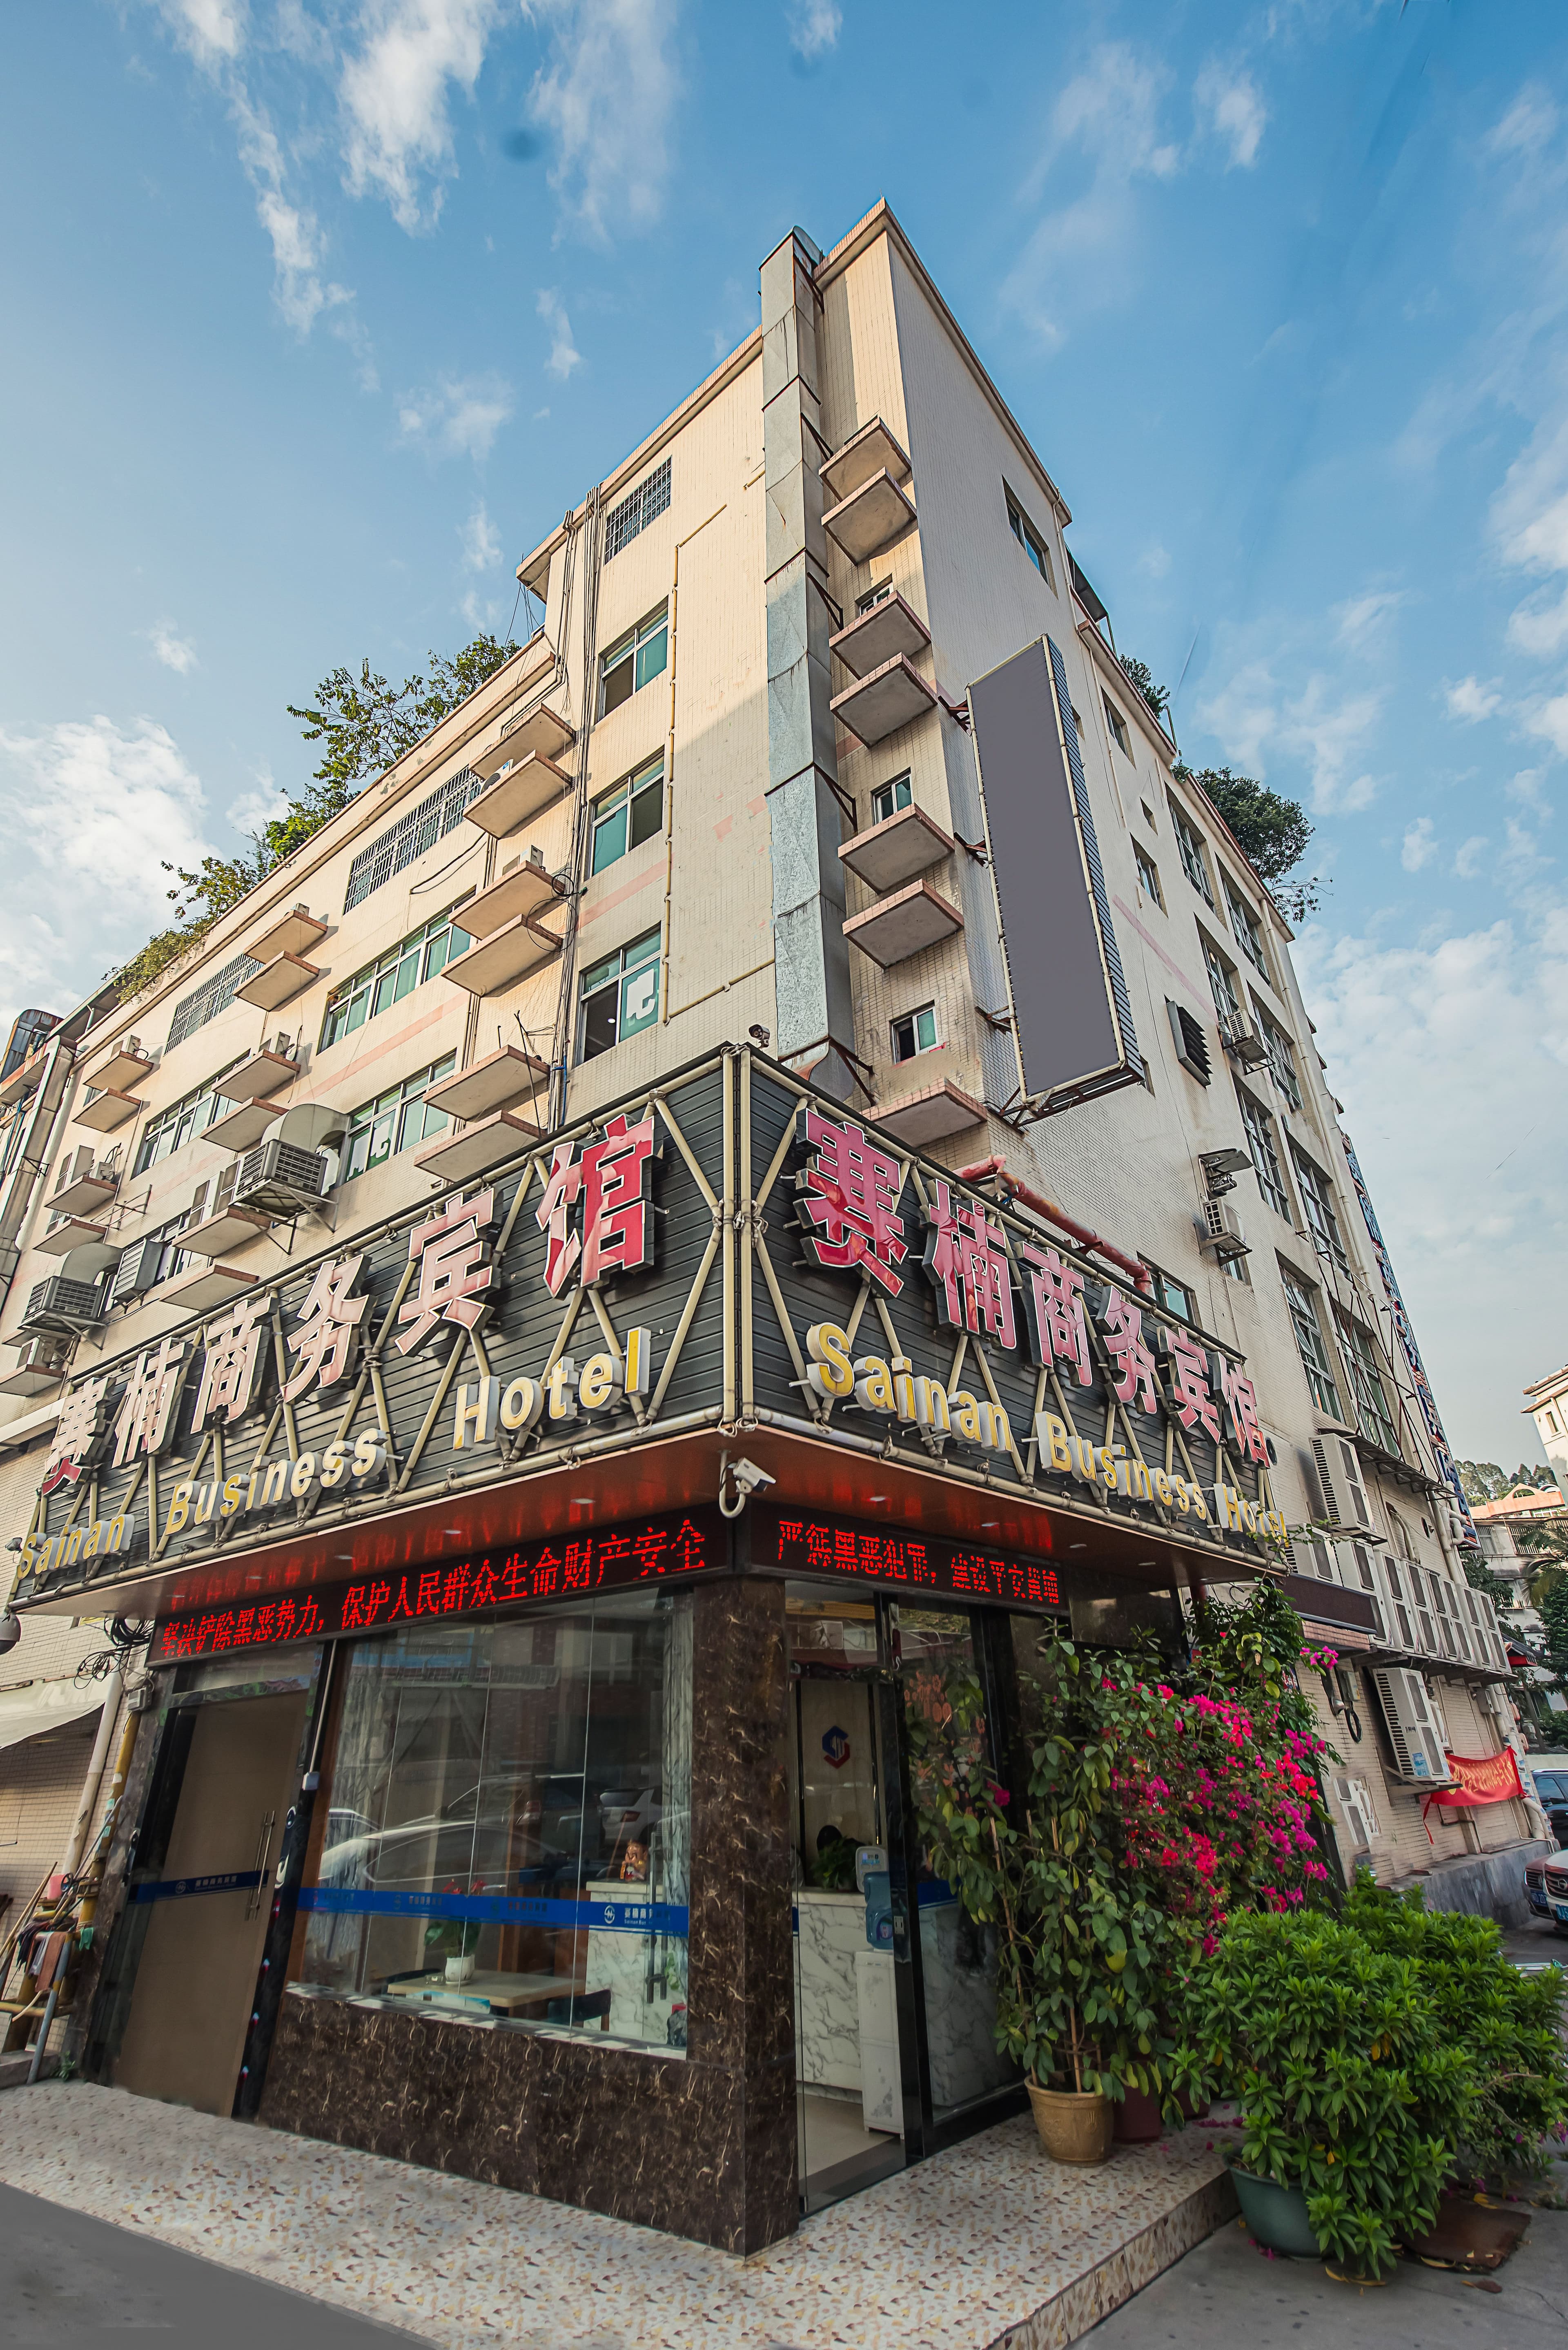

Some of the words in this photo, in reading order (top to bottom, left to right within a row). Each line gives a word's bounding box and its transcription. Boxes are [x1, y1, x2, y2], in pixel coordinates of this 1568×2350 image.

[42, 1114, 656, 1496] 赛楠商务宾馆
[799, 1108, 1271, 1469] 赛楠商务宾馆
[807, 1322, 1013, 1453] Sainan
[1036, 1411, 1207, 1520] Business
[1214, 1483, 1290, 1548] Hotel
[18, 1514, 131, 1580] Sainan
[165, 1428, 386, 1536] Business
[453, 1327, 651, 1451] Hotel
